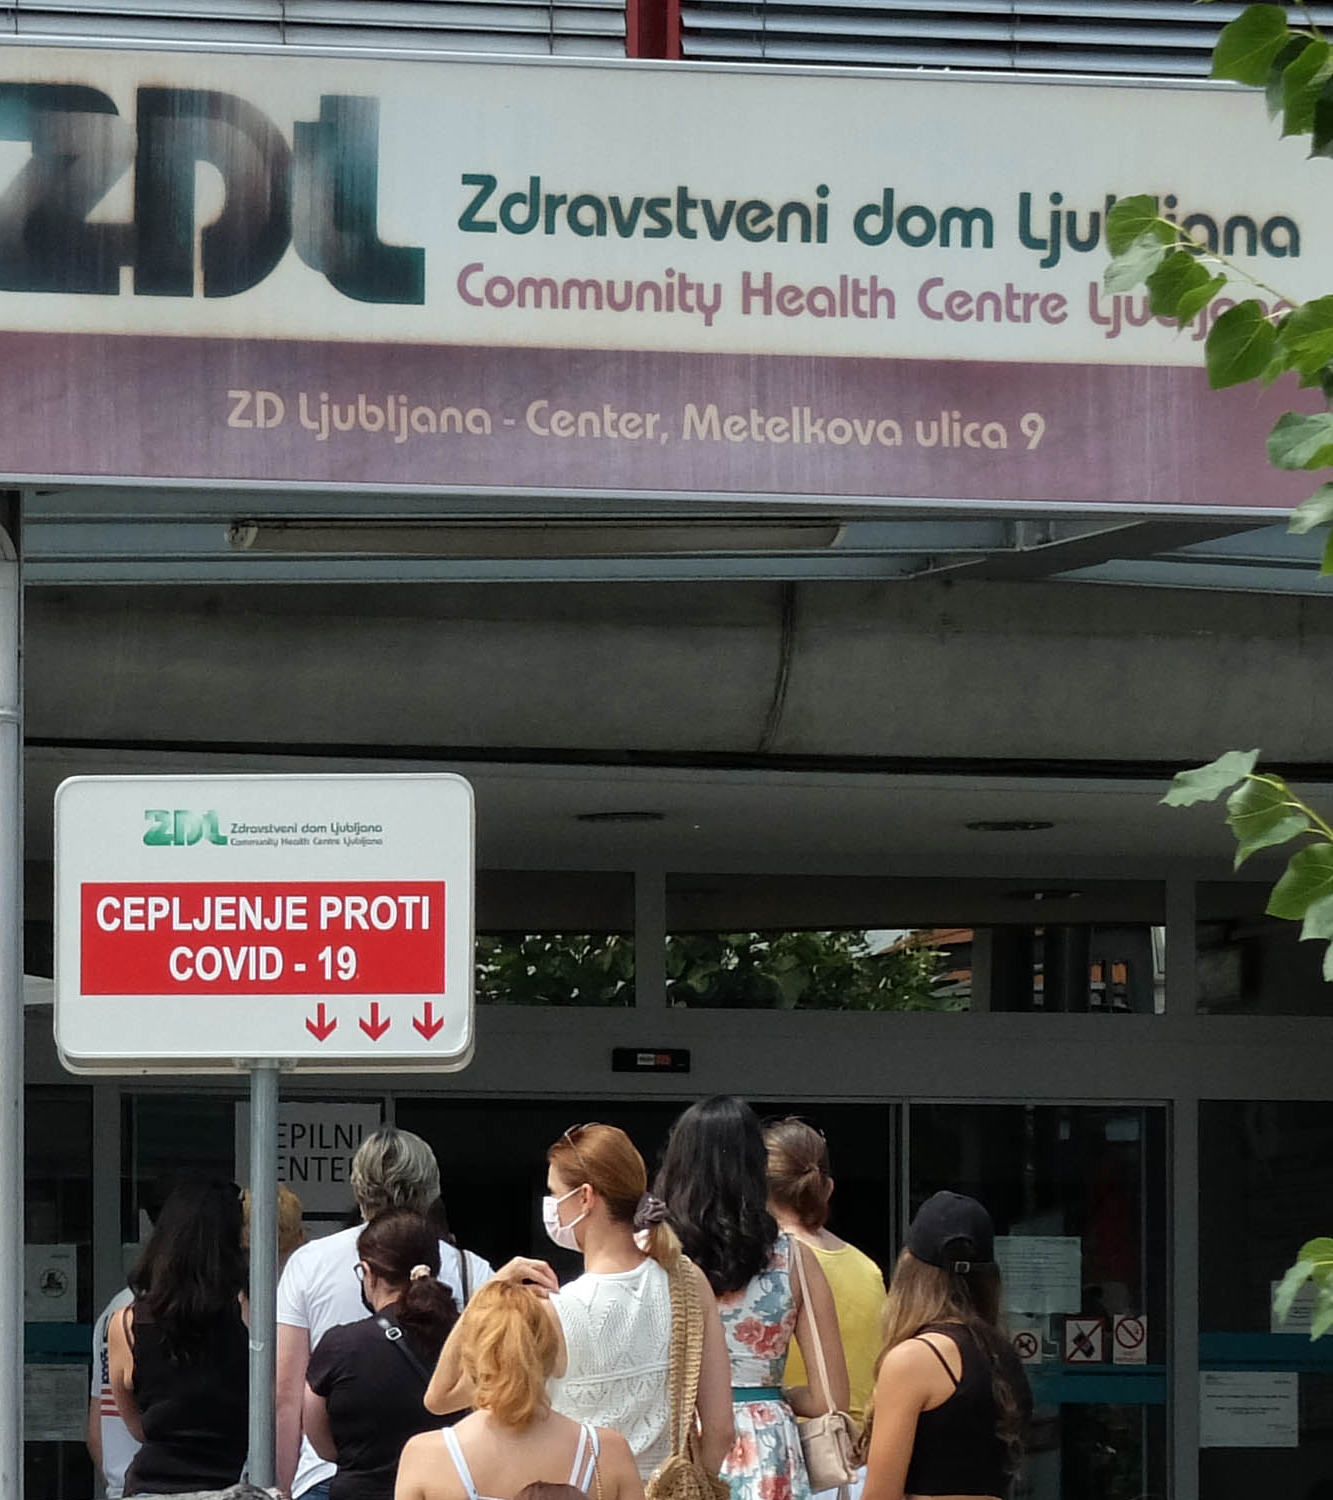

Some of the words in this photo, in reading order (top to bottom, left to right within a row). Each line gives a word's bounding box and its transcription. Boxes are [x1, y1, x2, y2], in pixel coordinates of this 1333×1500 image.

[457, 173, 830, 244] Zdravstveni
[853, 187, 993, 250] dom
[457, 262, 722, 327] Community
[741, 270, 896, 320] Health
[918, 276, 1069, 325] Centre
[227, 390, 285, 429] ZD
[299, 392, 492, 443] Ljubljana
[526, 400, 671, 447] Center,
[682, 404, 903, 446] Metelkova
[915, 410, 1008, 449] ulica
[1020, 412, 1046, 450] 9
[231, 822, 298, 834] Zdravstveni
[301, 822, 328, 834] dom
[331, 822, 383, 836] Ljubljana
[96, 896, 308, 931] CEPLJENJE
[319, 895, 430, 931] PROTI
[169, 946, 283, 981] COVID
[294, 963, 306, 972] -
[318, 945, 357, 981] 19
[277, 1122, 363, 1150] EPILNI
[277, 1156, 353, 1183] ENTE
